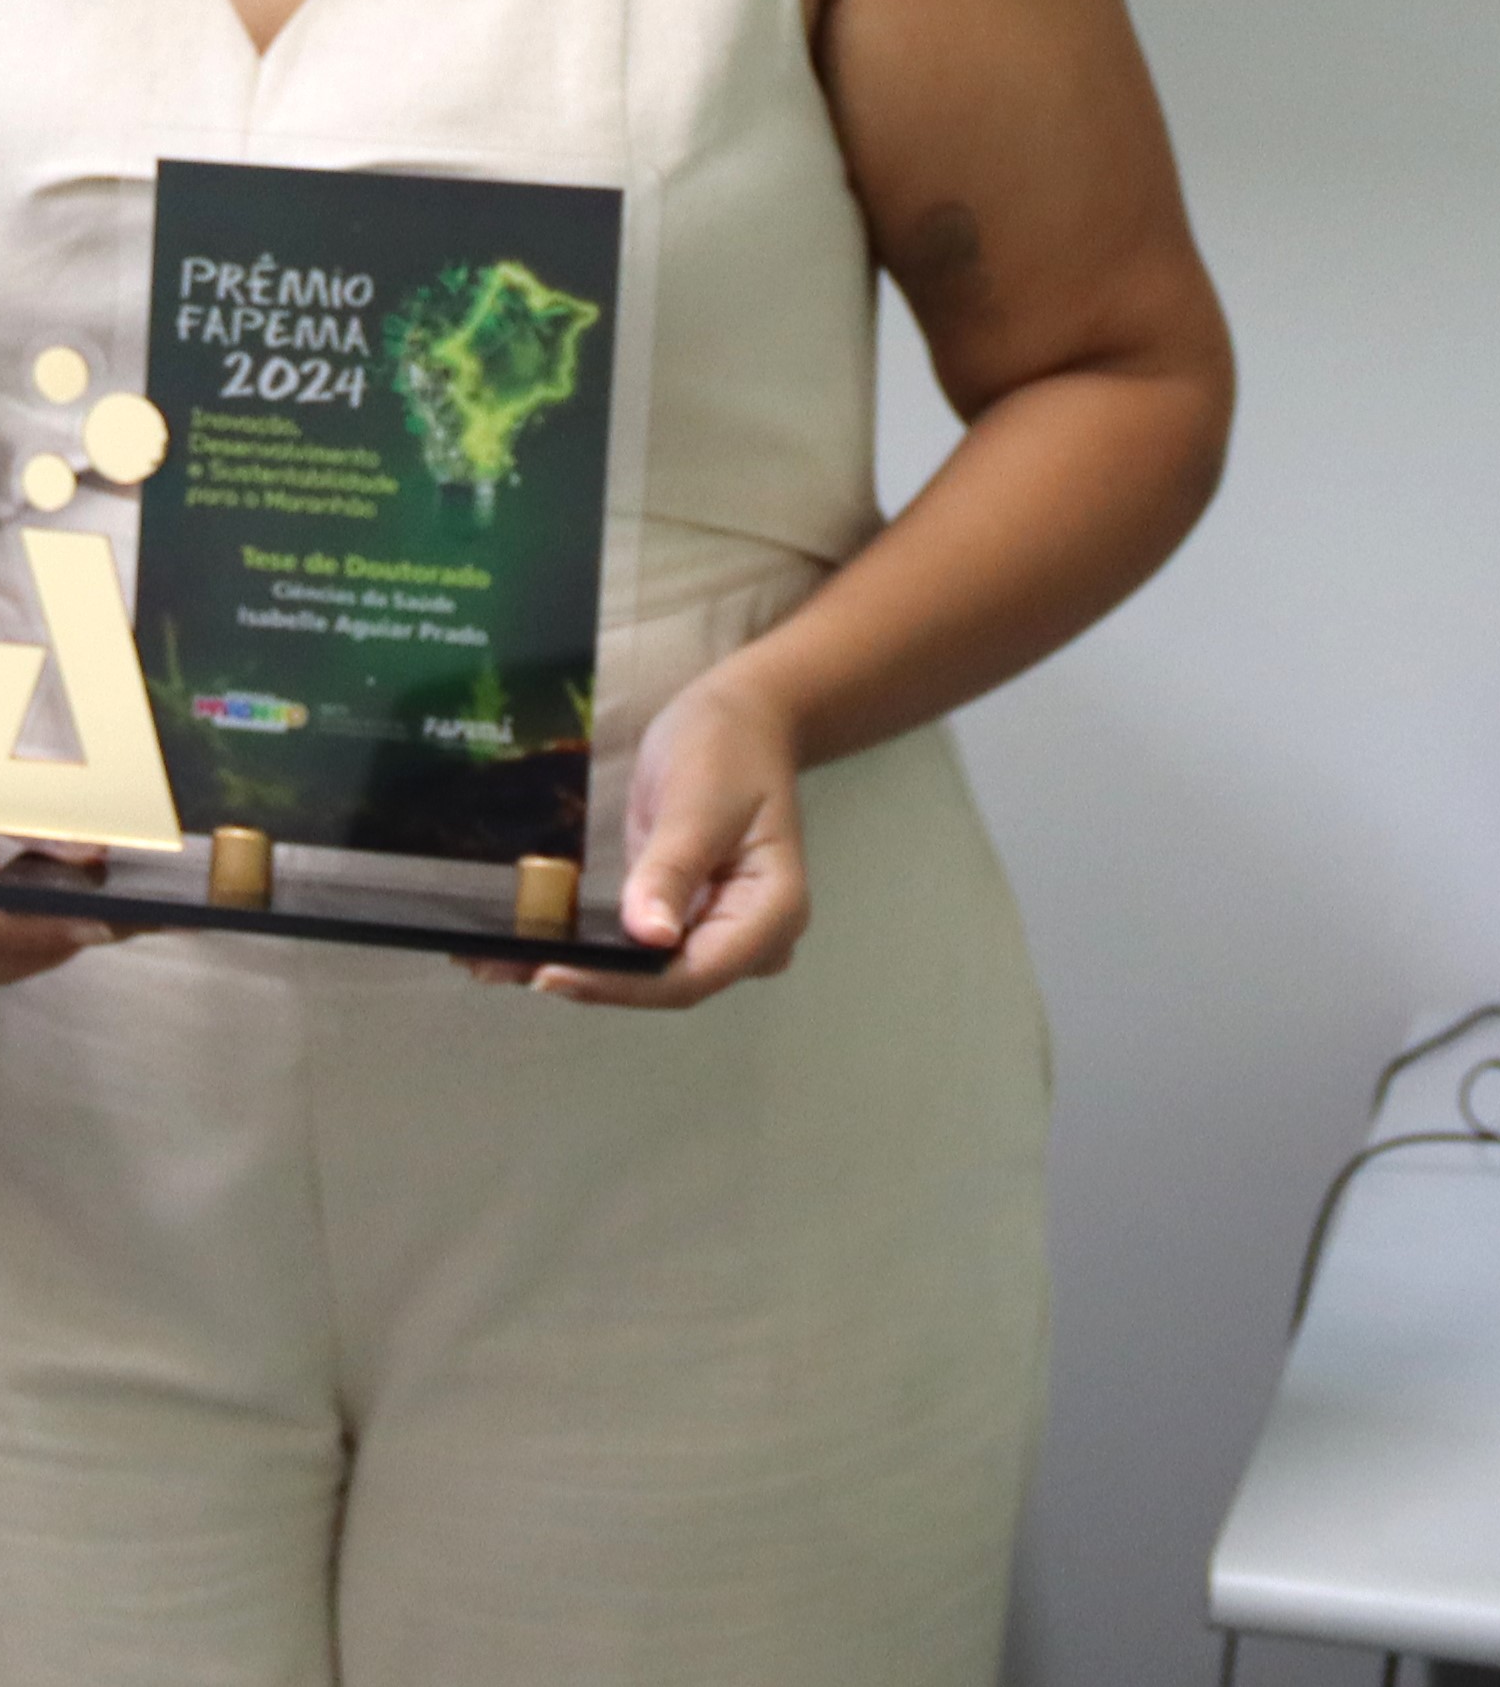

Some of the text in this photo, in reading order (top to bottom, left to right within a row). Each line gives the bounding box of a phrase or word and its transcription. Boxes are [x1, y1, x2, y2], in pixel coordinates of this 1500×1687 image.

[179, 251, 376, 309] PRÊMIO
[176, 303, 373, 358] FAPEMA
[219, 350, 368, 410] 2024
[188, 431, 383, 470] Desenvolvimento
[185, 457, 401, 496] e Sustentabilidade
[183, 485, 240, 509] para
[262, 489, 380, 520] Maranhão
[241, 543, 493, 591] Tese de Doutorado
[269, 578, 457, 615] Ciências da Saúde
[236, 604, 490, 648] Isabelle Aguiar Prado
